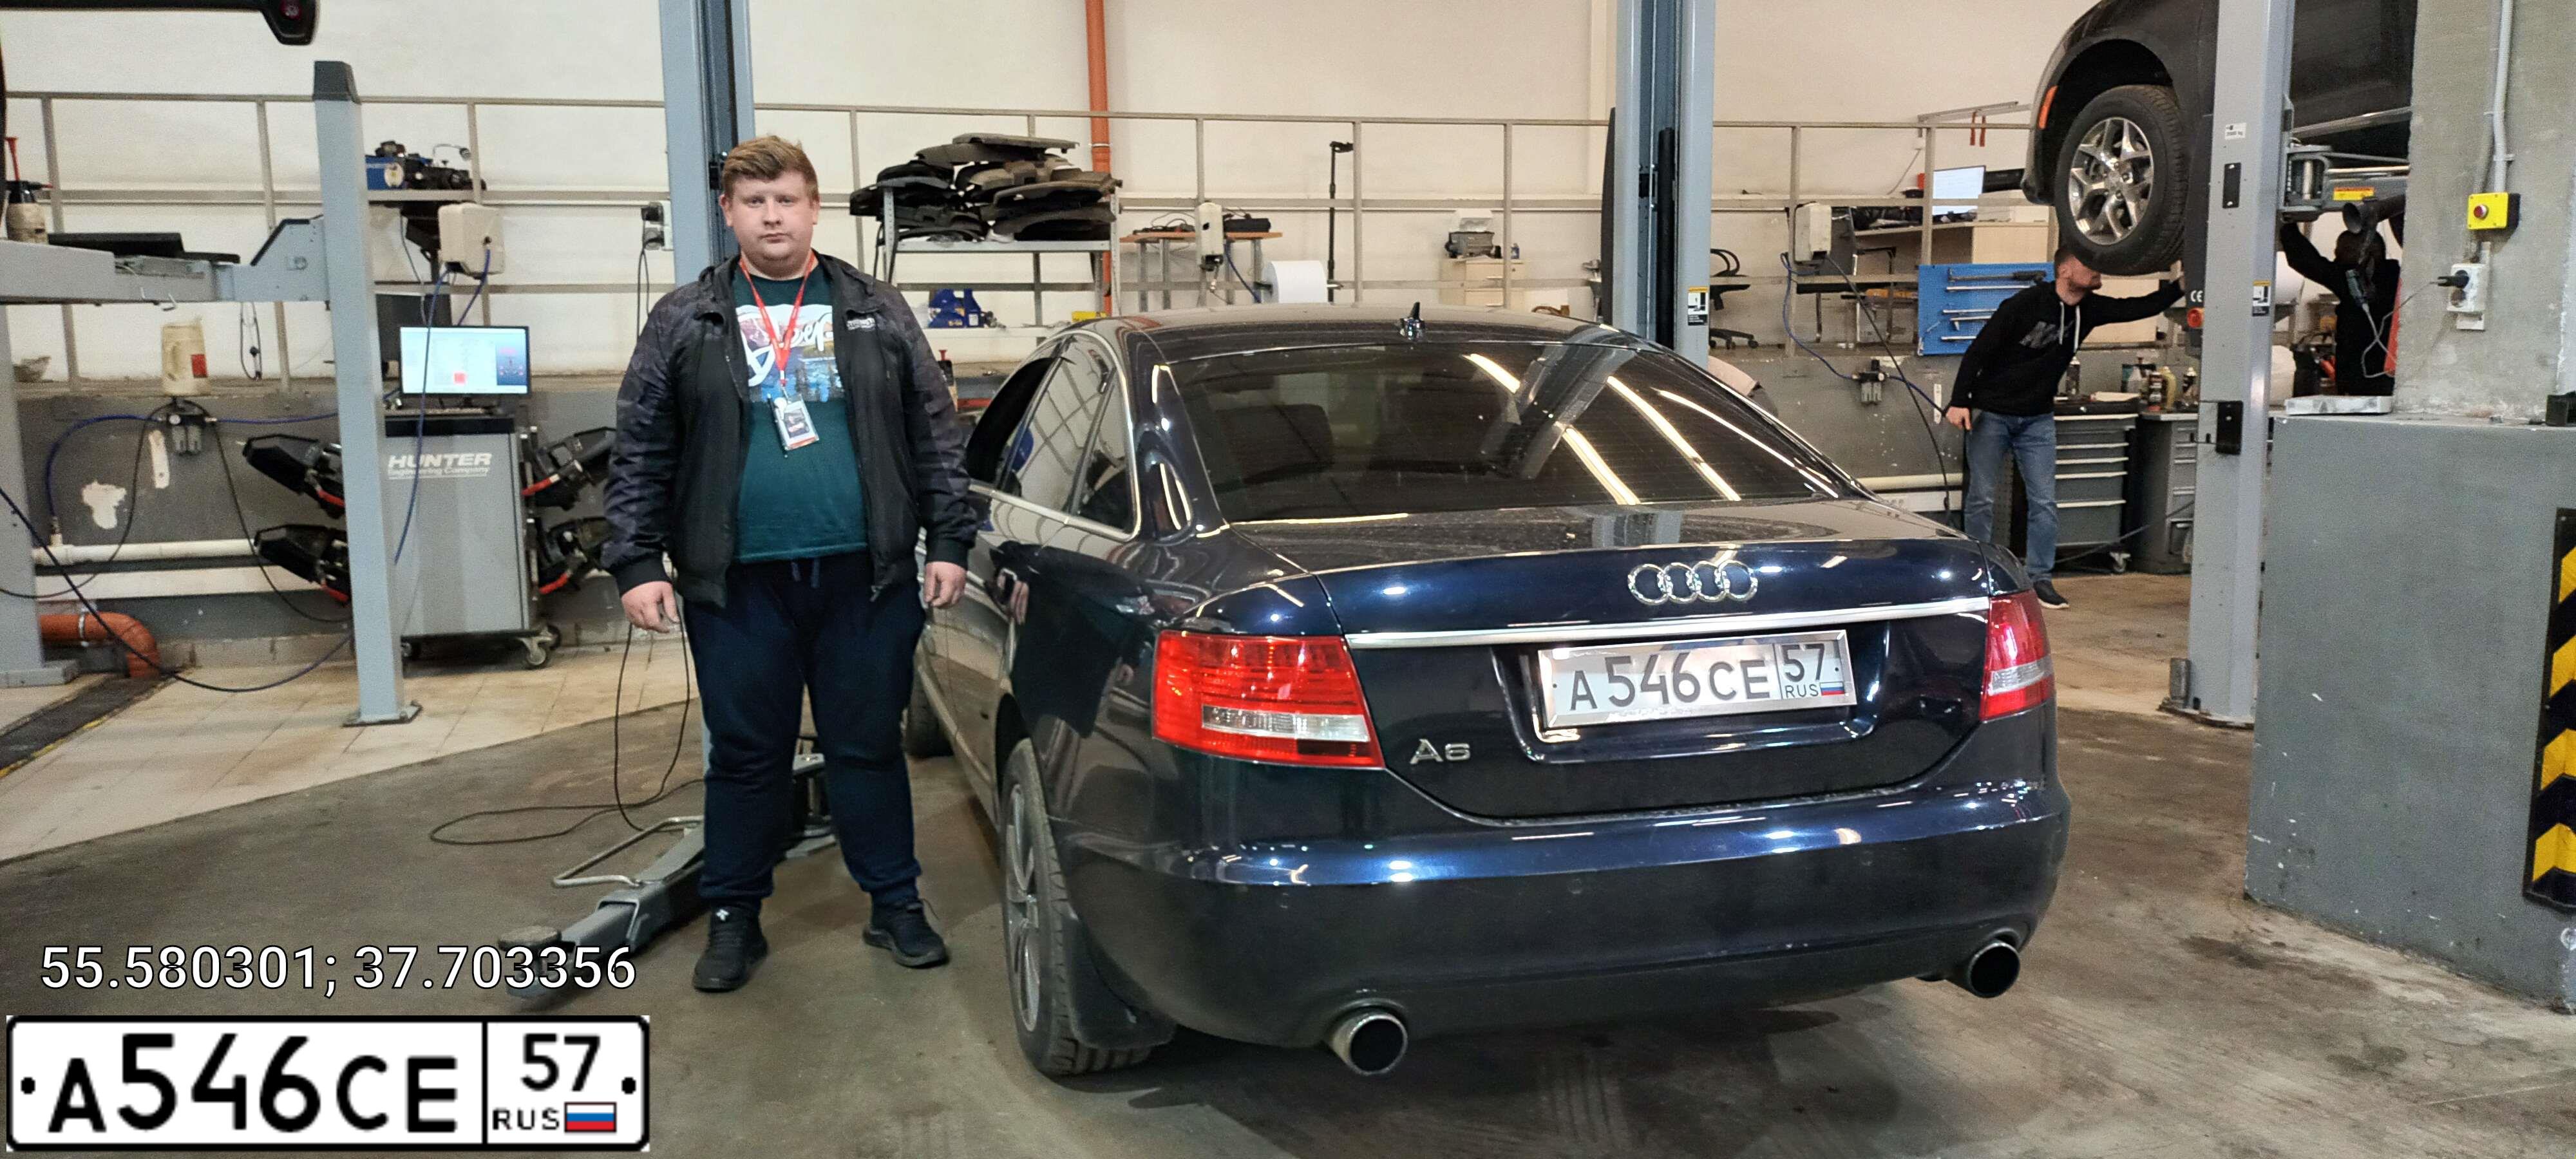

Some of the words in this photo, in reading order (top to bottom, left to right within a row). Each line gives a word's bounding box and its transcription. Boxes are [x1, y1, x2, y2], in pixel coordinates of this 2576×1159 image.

[2190, 290, 2203, 302] CE
[388, 453, 493, 469] HUNTER
[1781, 643, 1824, 683] 57
[1785, 683, 1819, 699] RUS
[1410, 738, 1471, 764] A6
